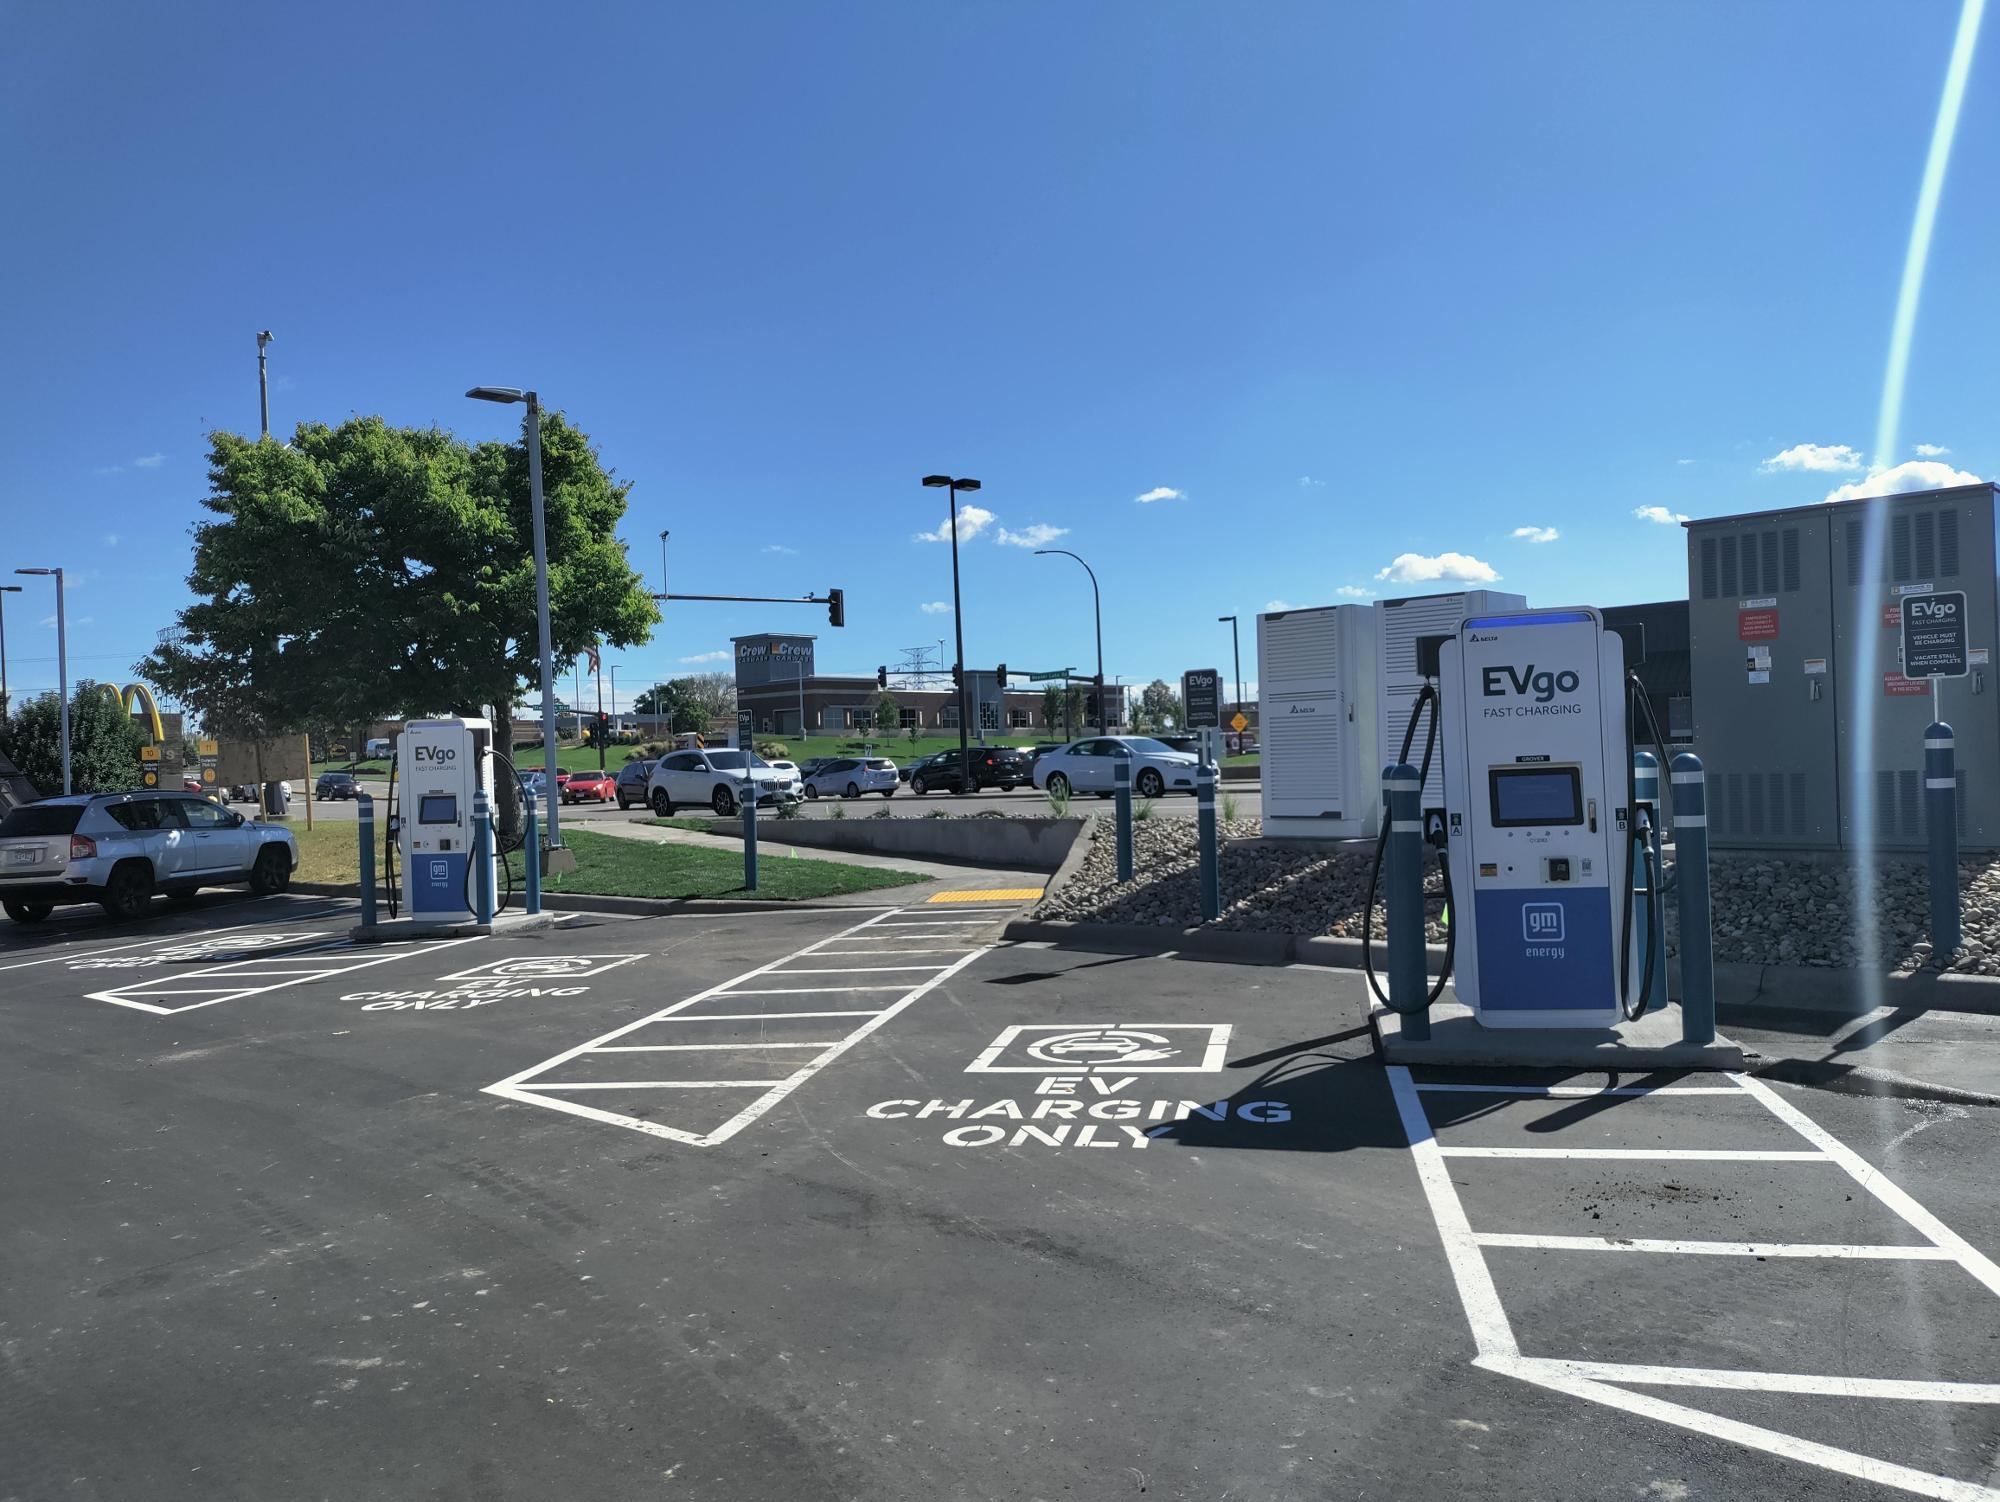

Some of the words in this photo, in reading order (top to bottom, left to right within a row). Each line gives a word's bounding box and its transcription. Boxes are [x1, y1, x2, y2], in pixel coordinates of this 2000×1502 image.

[1911, 601, 1956, 618] EVgo
[740, 645, 767, 657] Crew
[779, 643, 813, 656] Crew
[1929, 658, 1961, 666] COMPLETE
[1189, 675, 1213, 687] EVgo
[1482, 664, 1580, 703] EVgo
[1483, 707, 1513, 718] FAST
[1515, 704, 1582, 717] CHARGING
[415, 745, 456, 764] EVgo
[1452, 826, 1461, 834] A
[1618, 822, 1626, 830] B
[433, 864, 446, 875] gm
[1529, 912, 1558, 933] gm
[1525, 947, 1565, 960] energy
[456, 979, 533, 989] EV
[339, 986, 591, 1001] CHARGING
[361, 998, 503, 1011] ONLY
[1034, 1076, 1139, 1095] EV
[865, 1099, 1292, 1122] CHARGING
[942, 1125, 1176, 1149] ONLY
